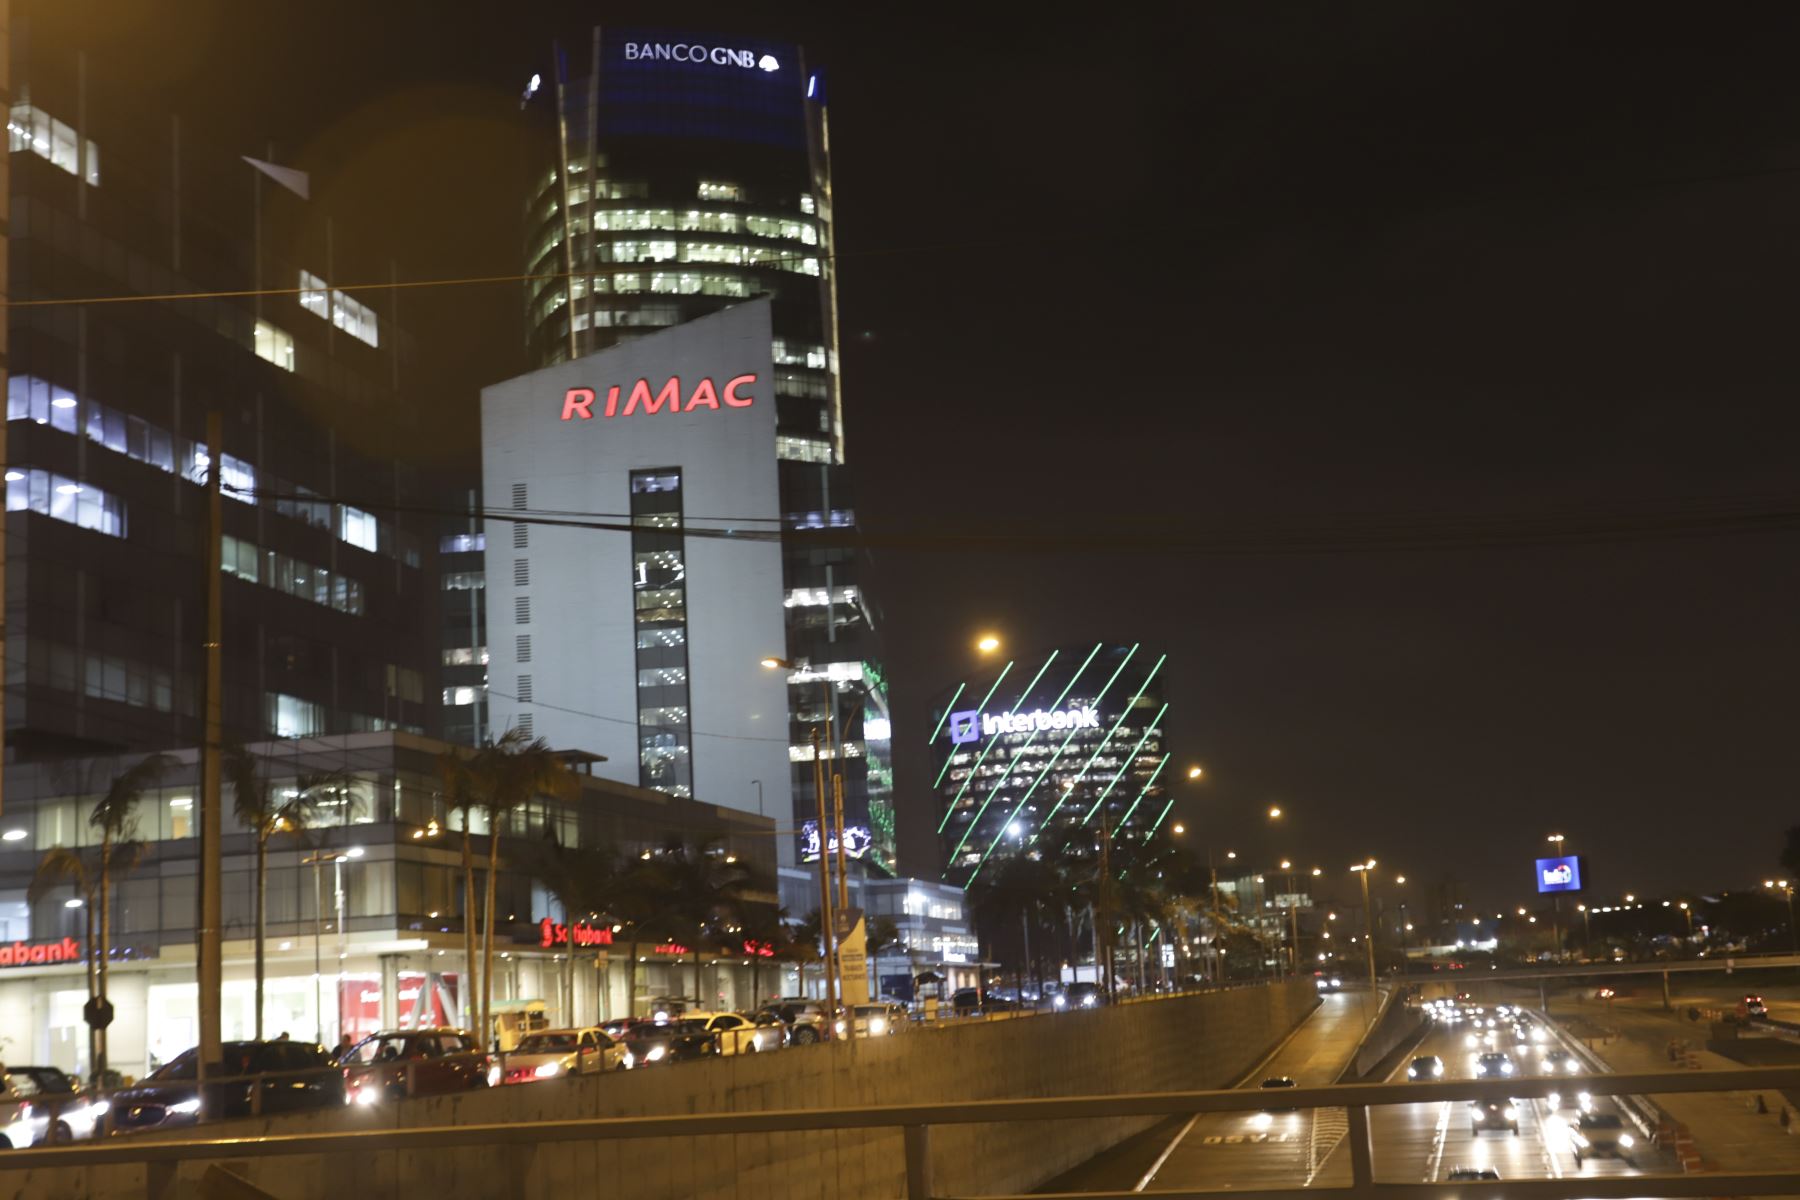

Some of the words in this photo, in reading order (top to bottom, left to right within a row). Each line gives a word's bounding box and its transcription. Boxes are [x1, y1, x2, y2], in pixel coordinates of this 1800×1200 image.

[625, 42, 708, 63] BANCO
[710, 47, 755, 69] GNB
[560, 373, 758, 421] RIMAC
[982, 706, 1100, 735] Interbank
[555, 922, 613, 945] Sctiabank
